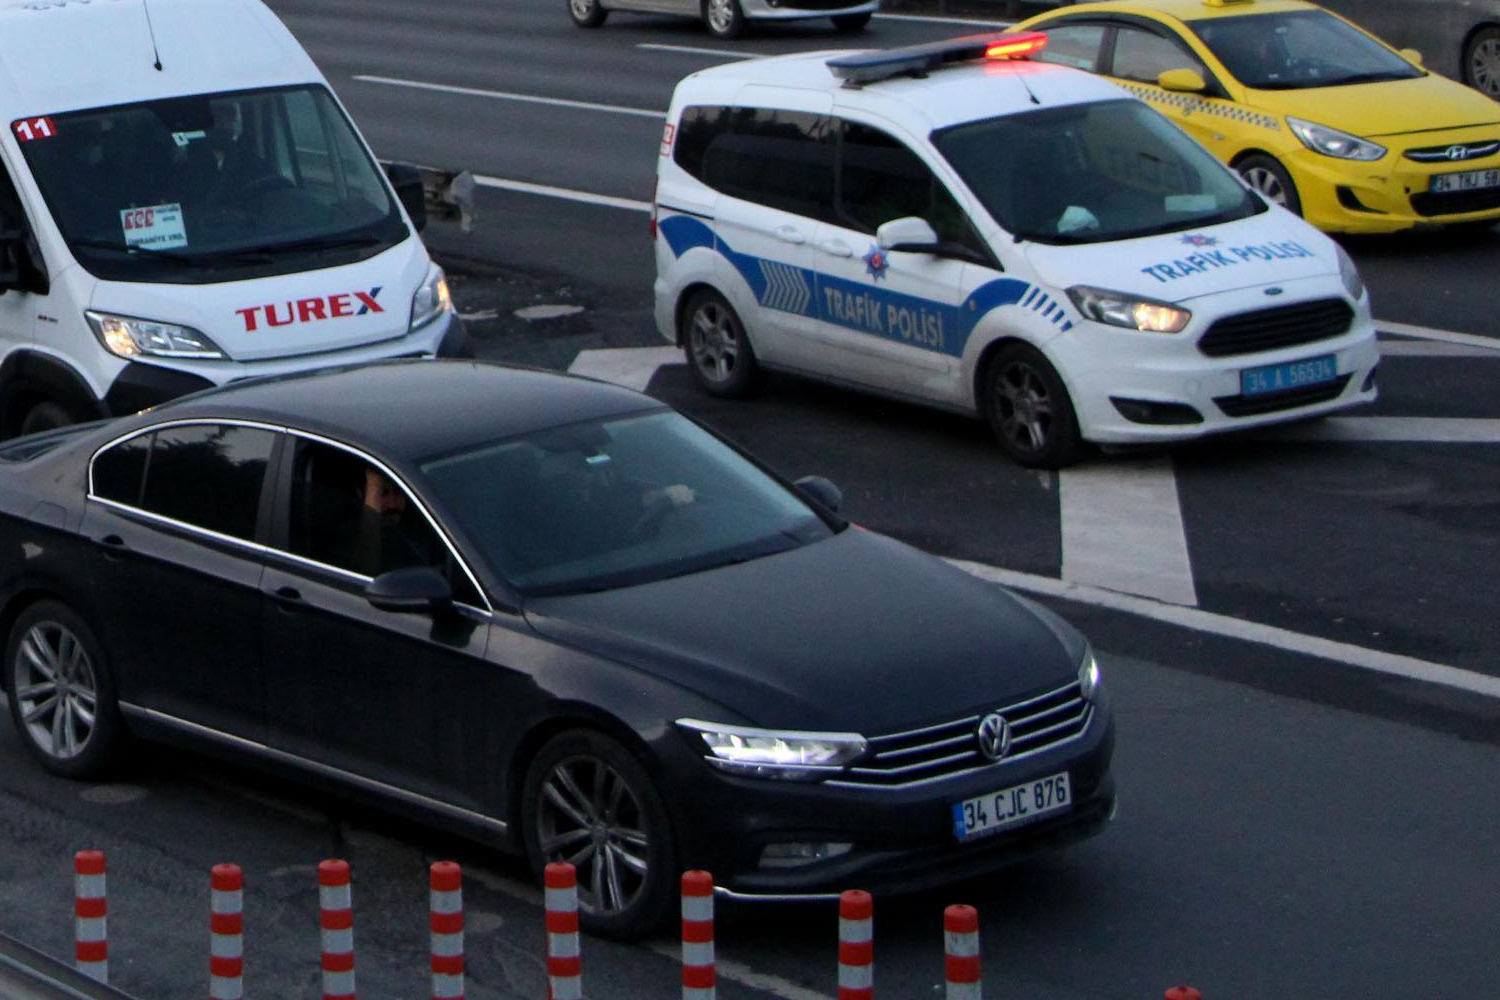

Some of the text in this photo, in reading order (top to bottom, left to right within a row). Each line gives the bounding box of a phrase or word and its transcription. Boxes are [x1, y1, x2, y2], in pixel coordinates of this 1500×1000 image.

[17, 118, 51, 140] 11
[1140, 249, 1238, 283] TRAFİK
[235, 286, 385, 332] TUREX
[824, 287, 883, 332] TRAFİK
[965, 800, 987, 829] 34
[995, 786, 1028, 820] CJC
[1034, 776, 1066, 809] 876
